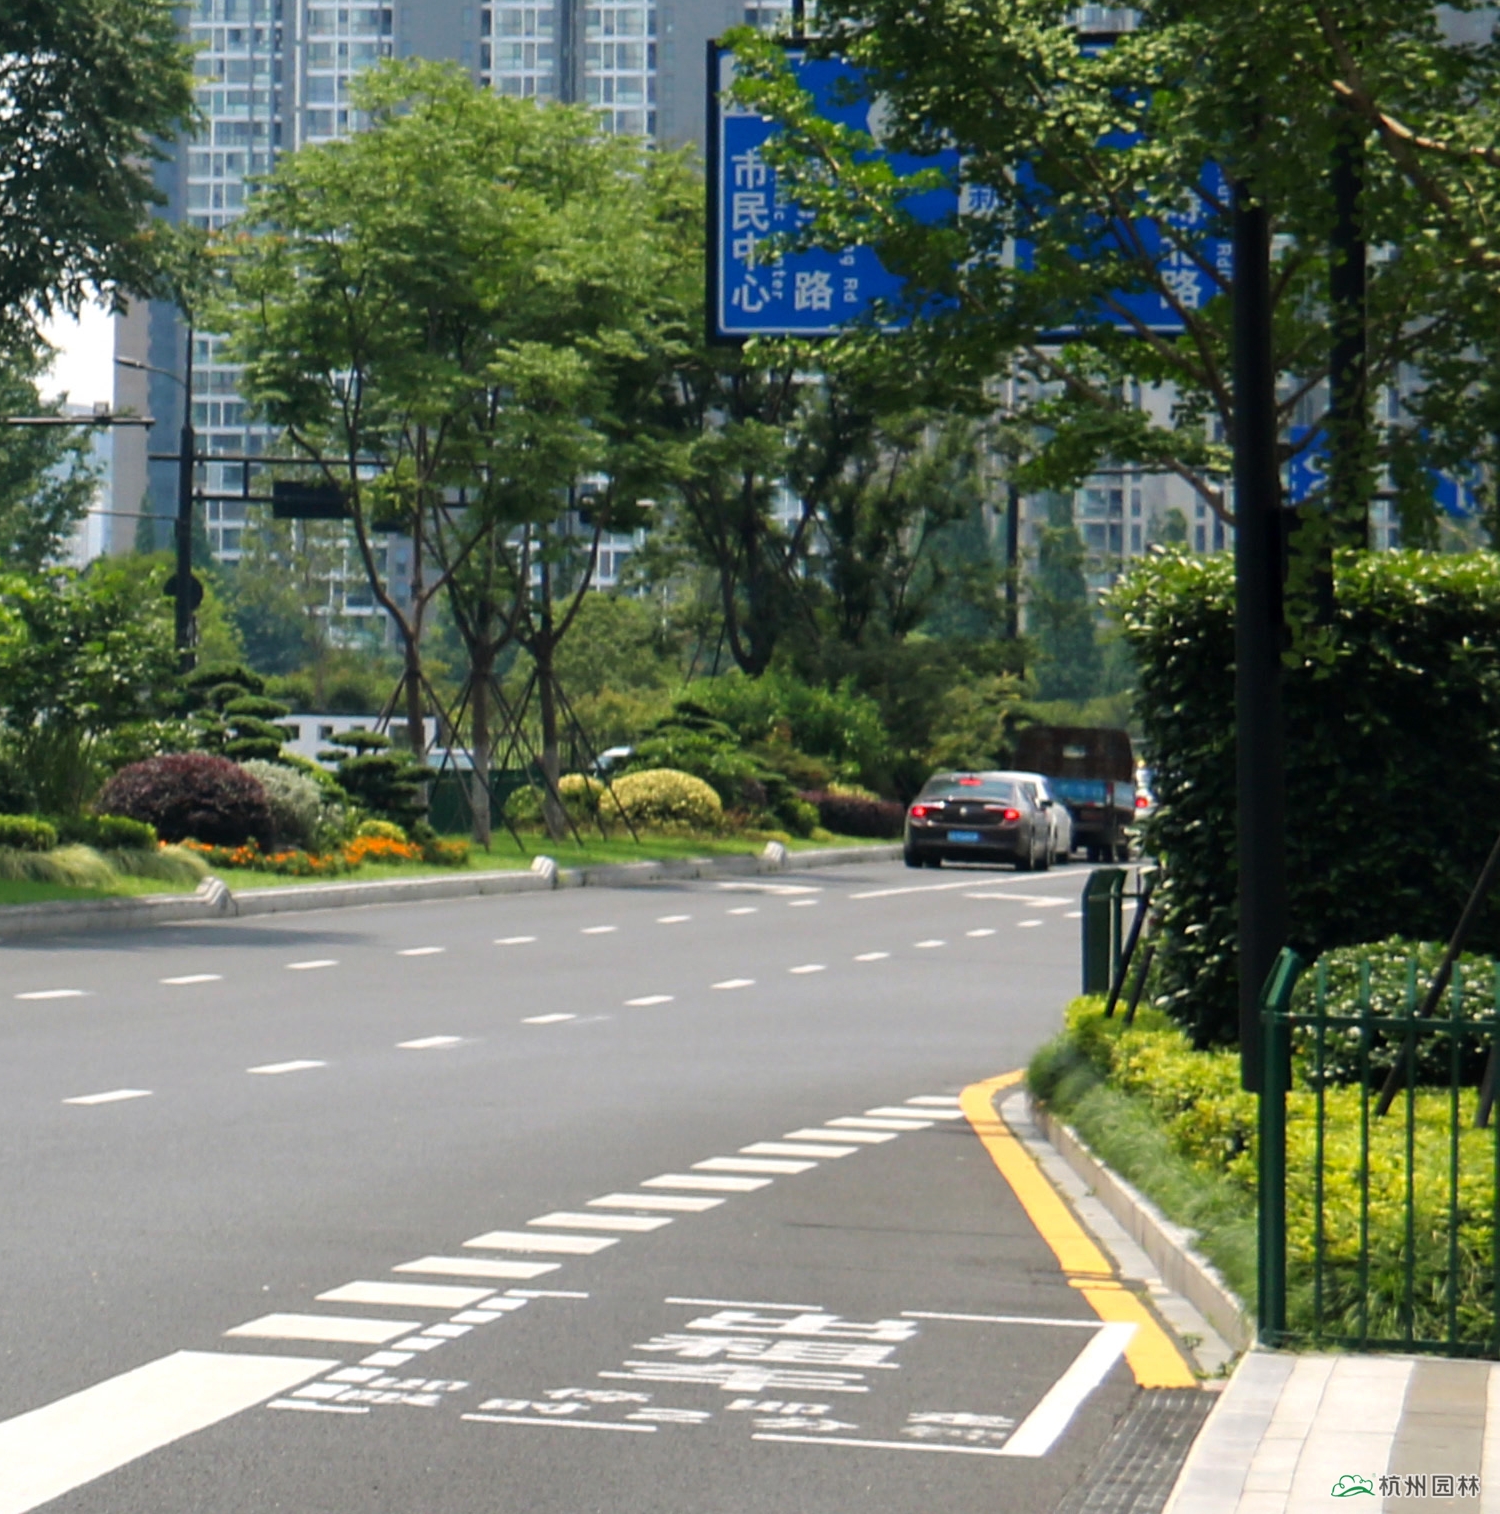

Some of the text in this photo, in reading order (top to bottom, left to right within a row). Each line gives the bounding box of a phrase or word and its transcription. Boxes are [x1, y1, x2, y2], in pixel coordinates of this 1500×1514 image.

[731, 149, 770, 313] 市民中心
[843, 277, 859, 303] Rd
